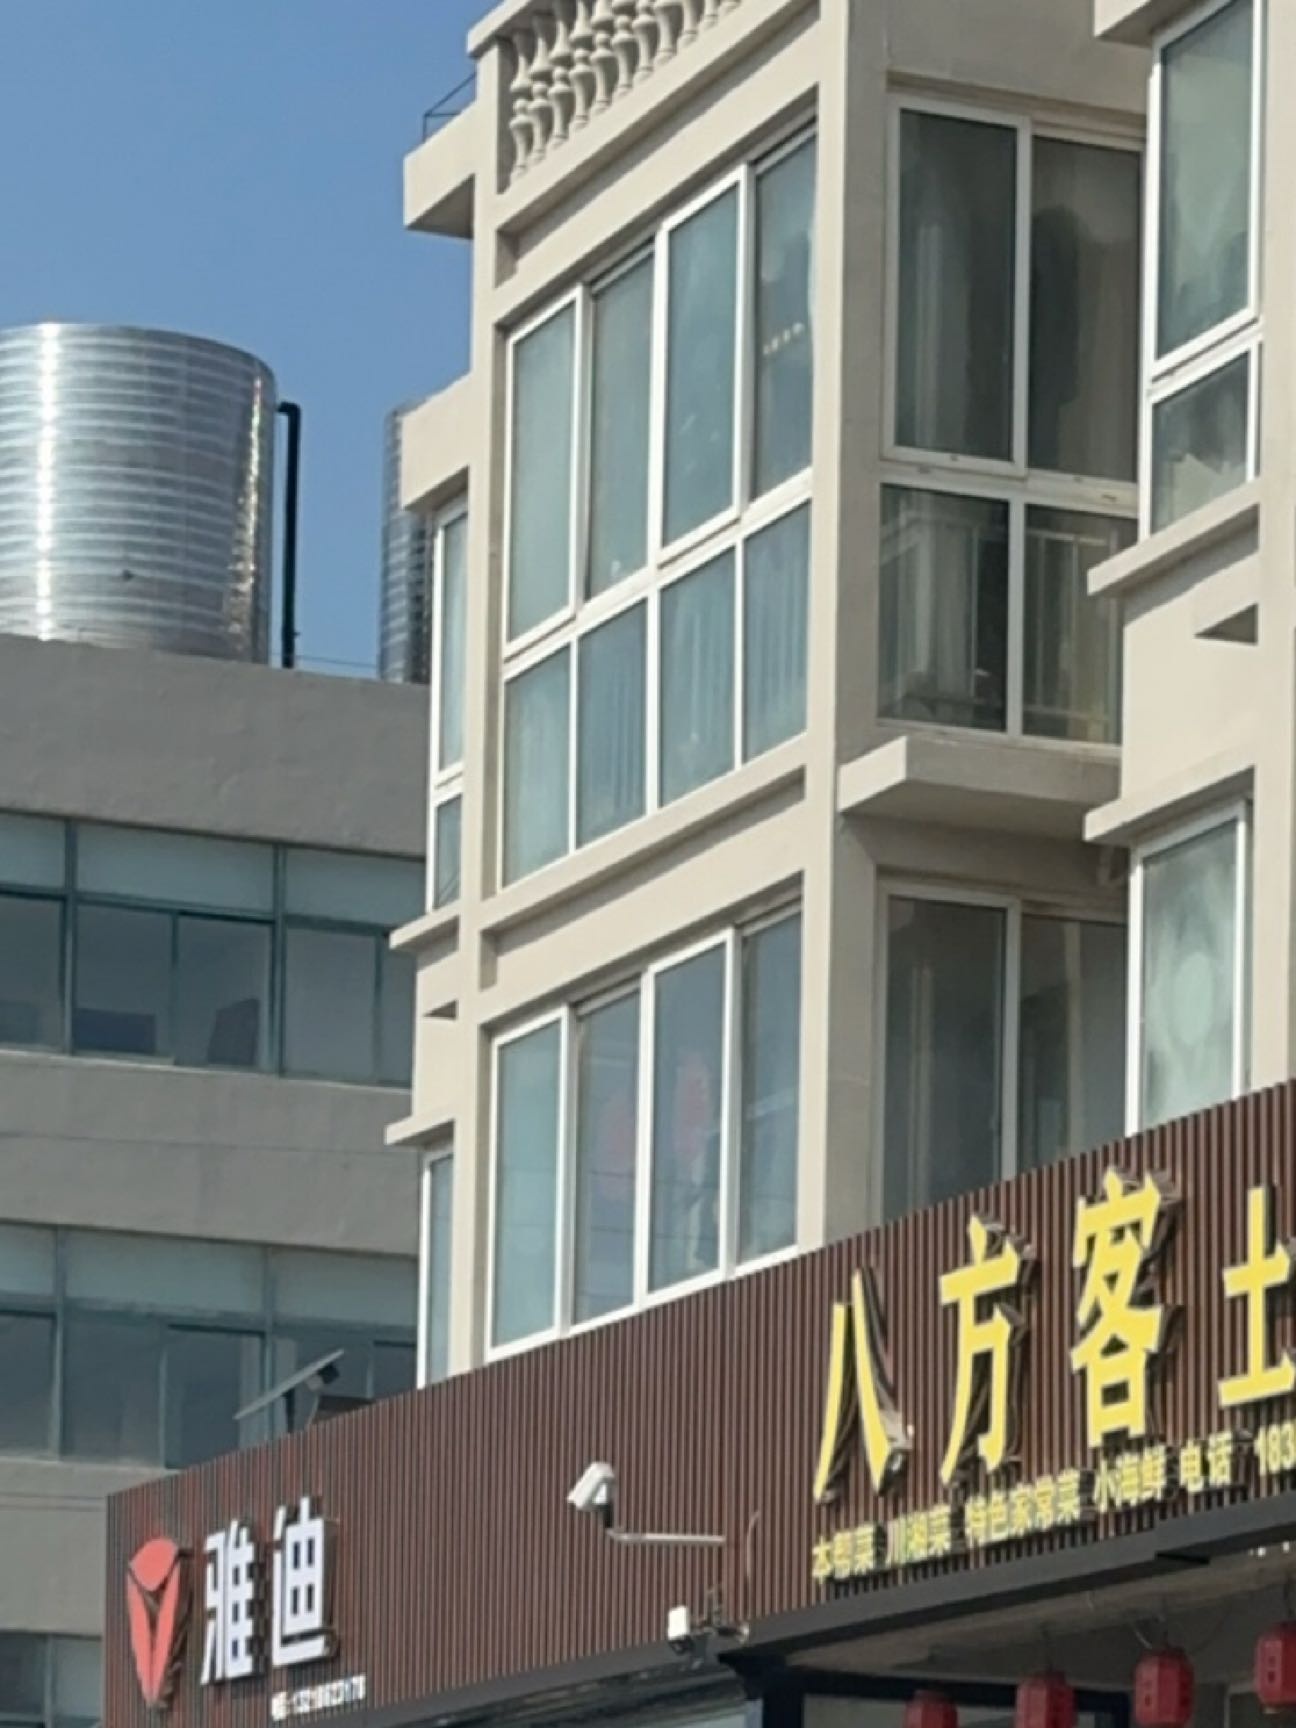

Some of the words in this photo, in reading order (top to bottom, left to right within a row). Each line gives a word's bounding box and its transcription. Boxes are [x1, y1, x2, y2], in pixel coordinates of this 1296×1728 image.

[964, 1469, 1082, 1550] 特色家常菜
[1094, 1445, 1167, 1514] 小海鲜
[1179, 1431, 1233, 1493] 电话
[200, 1496, 326, 1686] 雅迪
